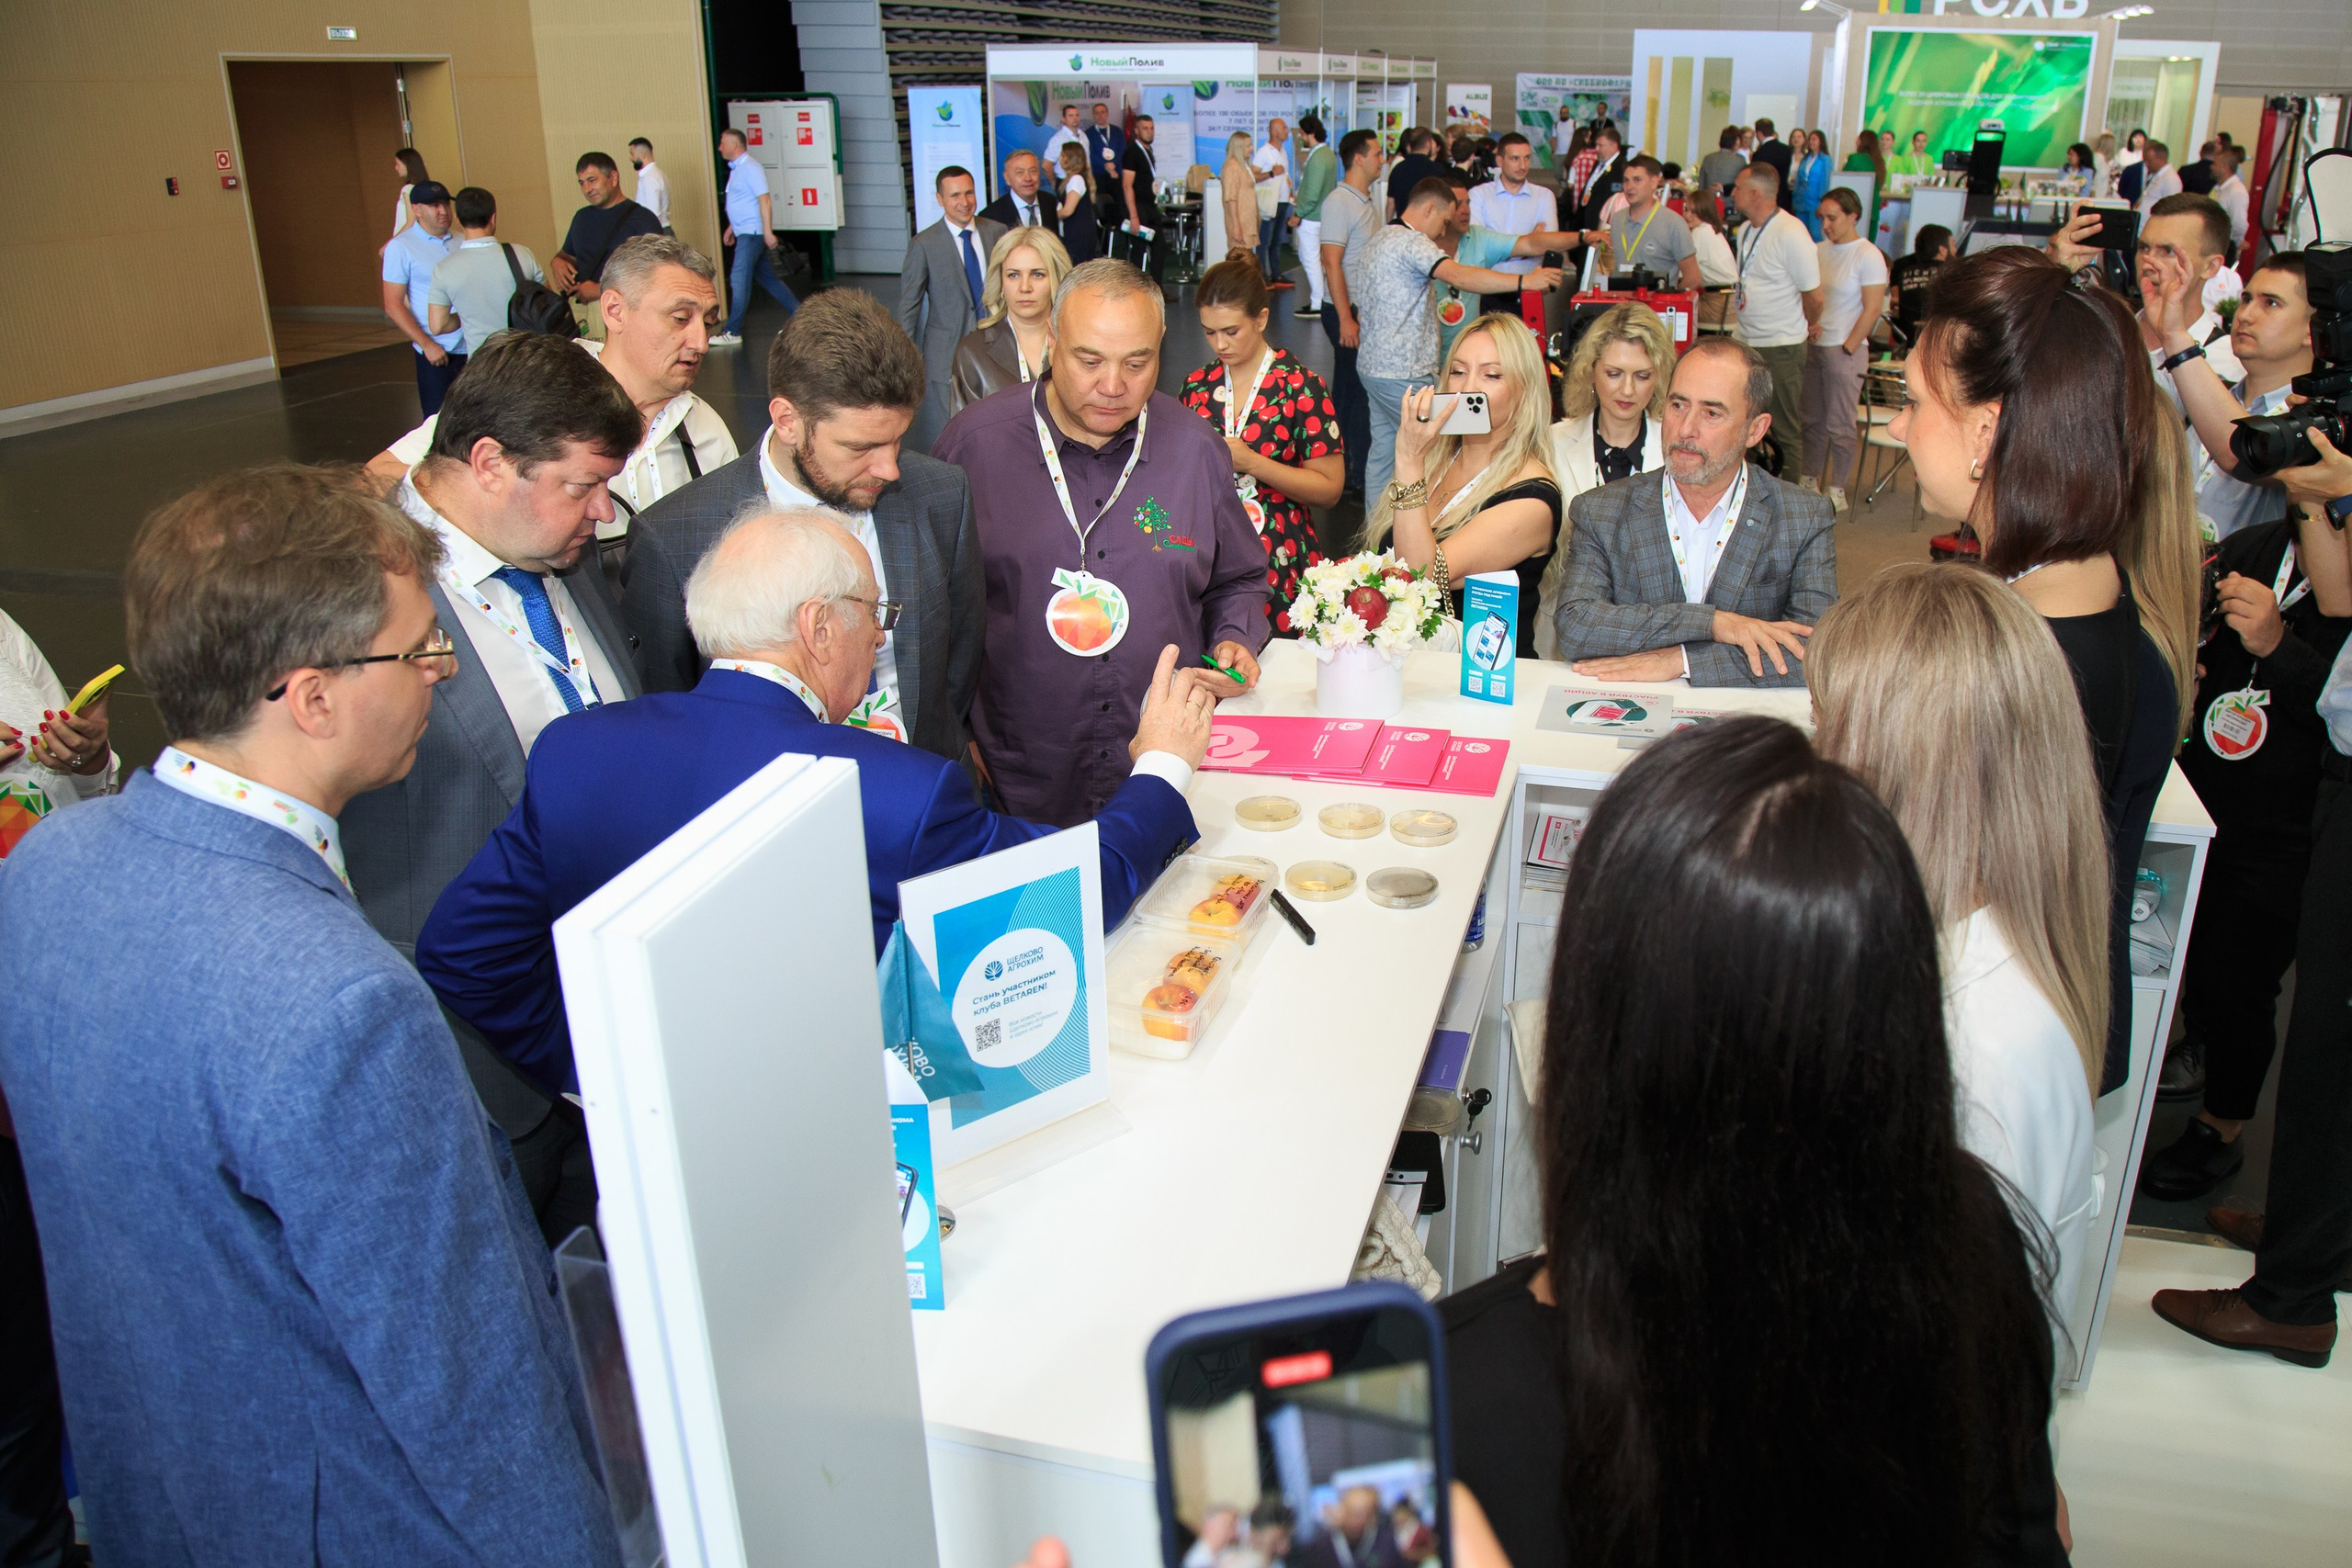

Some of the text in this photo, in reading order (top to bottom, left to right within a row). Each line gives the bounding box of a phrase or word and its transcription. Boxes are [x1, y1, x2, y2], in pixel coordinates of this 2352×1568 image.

[1091, 56, 1165, 67] НовыйПолив
[1006, 946, 1044, 965] ЩЕЛКОВО
[1007, 954, 1044, 974] АГРОХИМ
[972, 969, 1057, 1006] Стань участником
[973, 982, 1047, 1016] клуба BETAREN!
